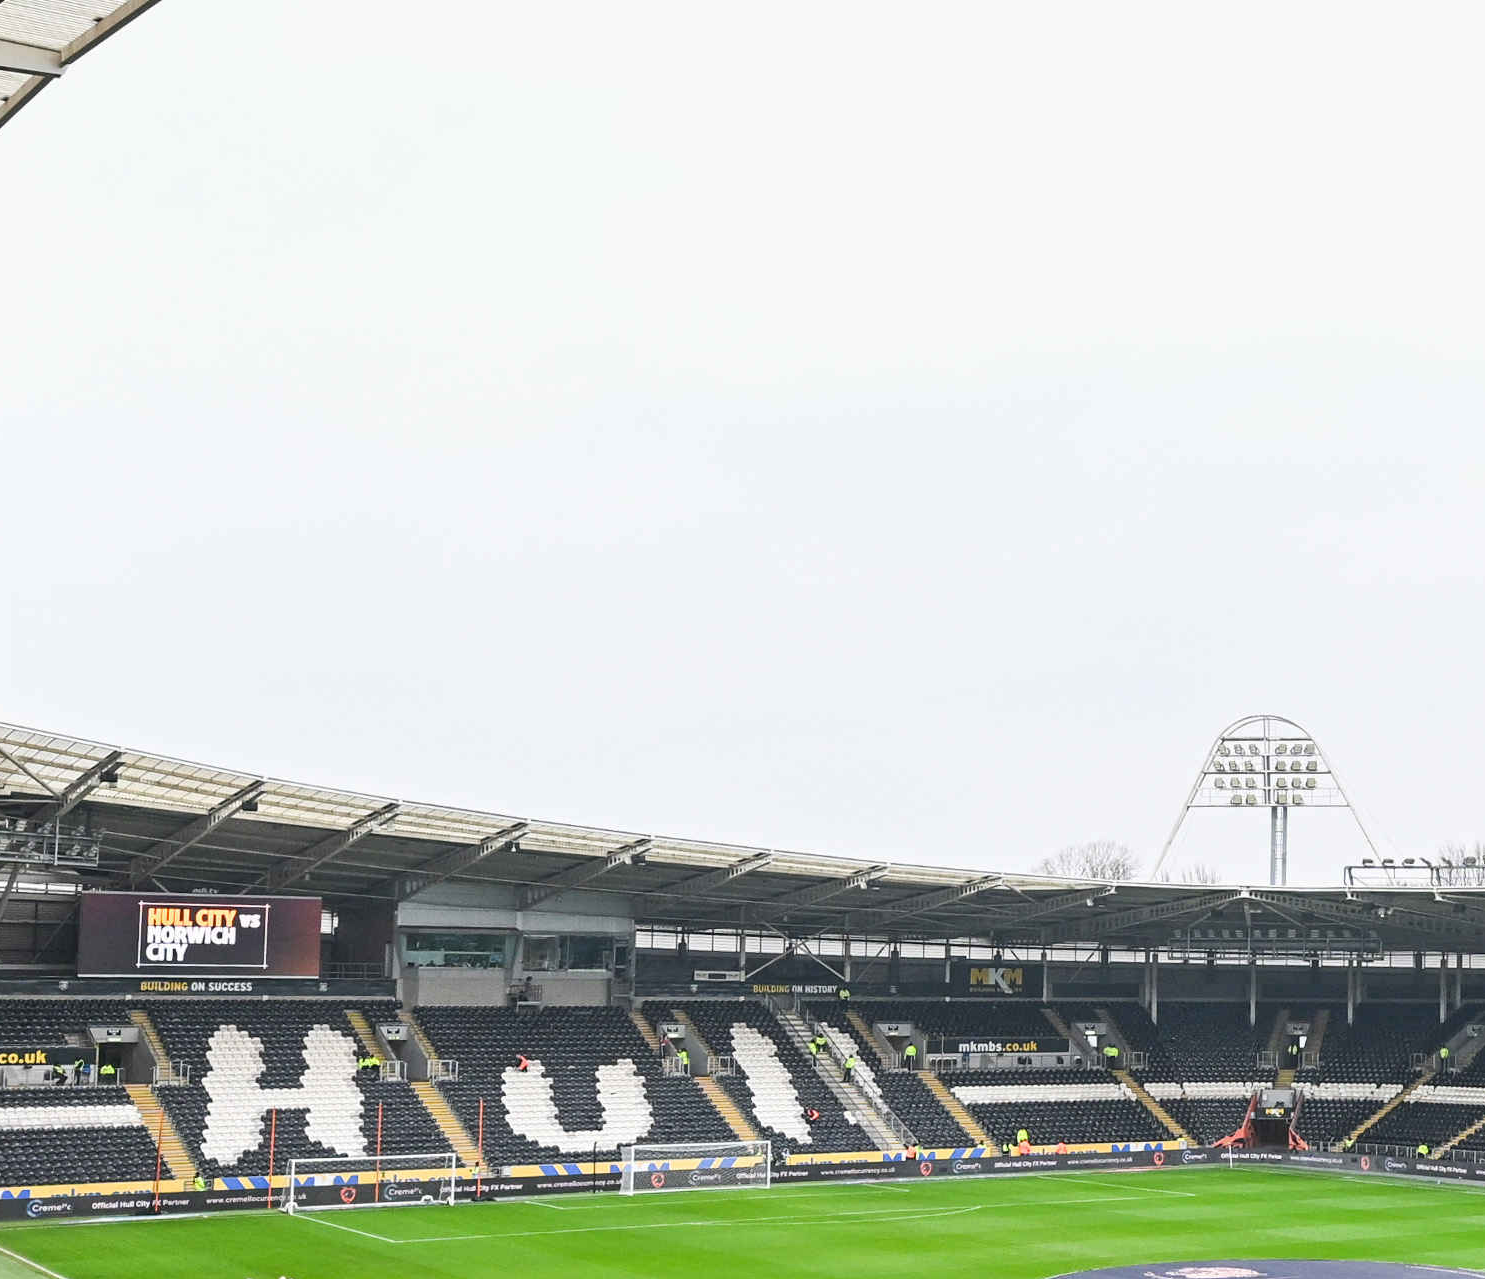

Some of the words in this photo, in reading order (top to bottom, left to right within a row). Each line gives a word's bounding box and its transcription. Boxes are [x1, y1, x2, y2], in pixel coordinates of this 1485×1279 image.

[148, 908, 193, 926] HULL
[195, 909, 237, 927] CITY
[147, 926, 236, 945] NORWICH
[146, 943, 188, 961] CITY
[140, 982, 188, 991] BUILDING
[191, 982, 205, 991] ON
[208, 982, 252, 992] SUCCESS
[753, 984, 790, 993] BUILDING
[791, 984, 803, 993] ON
[805, 984, 838, 994] HISTORY
[970, 968, 1023, 993] MKM
[958, 1038, 1038, 1053] mkmbs.co.uk
